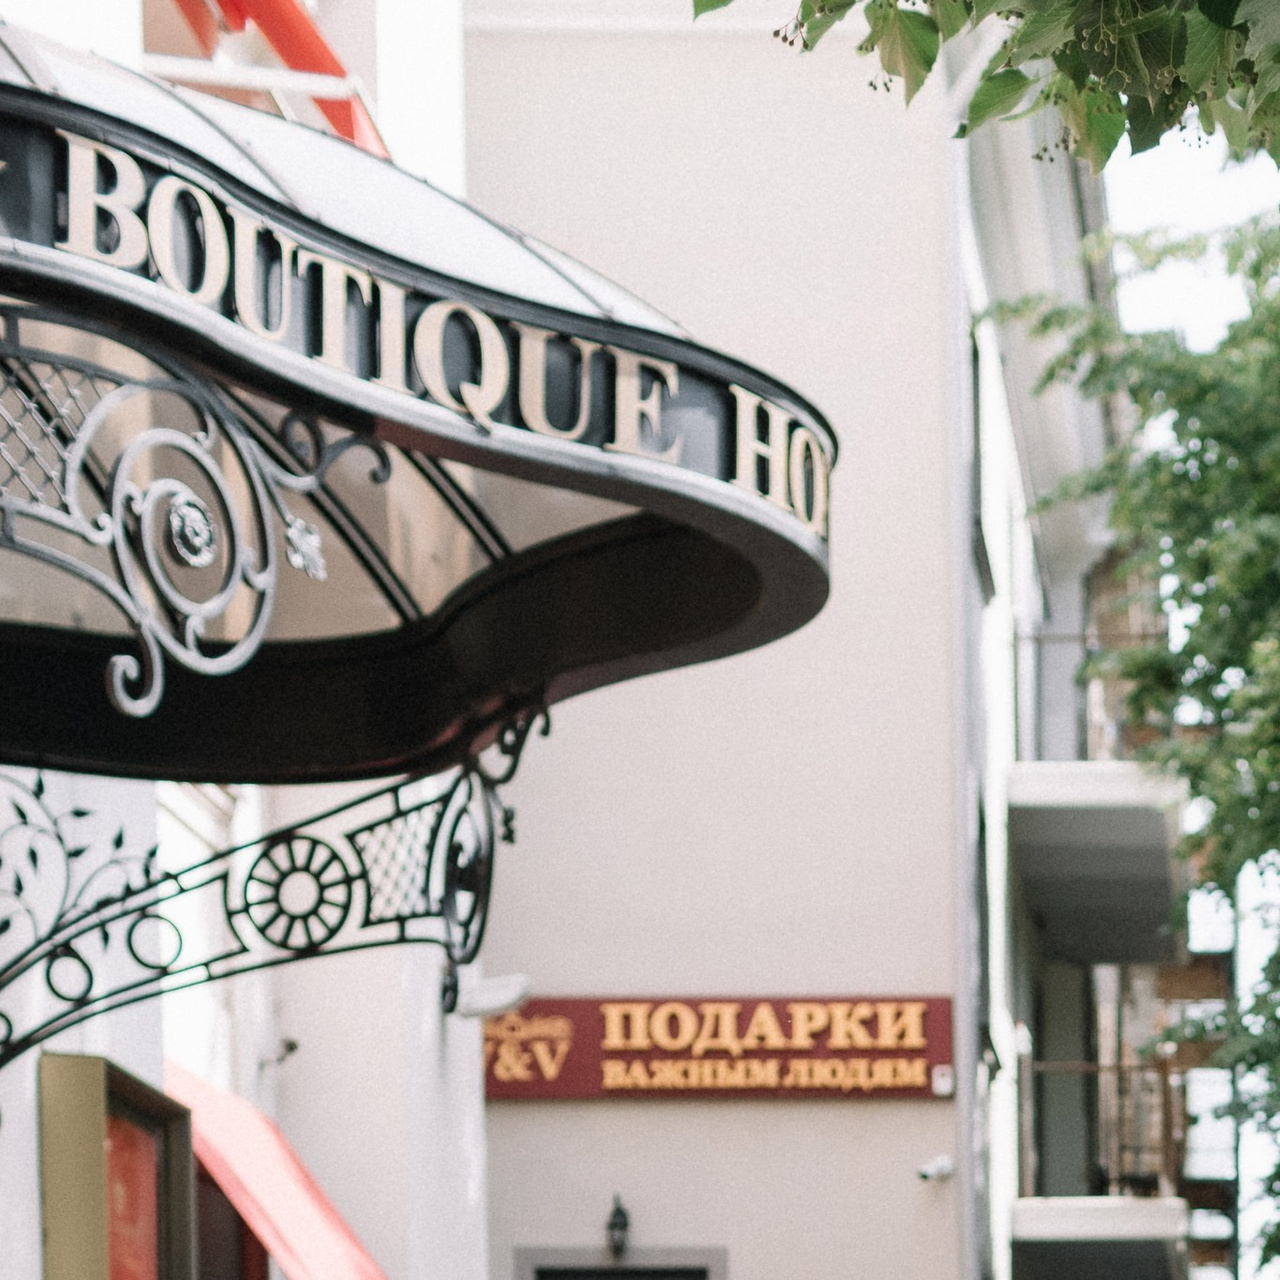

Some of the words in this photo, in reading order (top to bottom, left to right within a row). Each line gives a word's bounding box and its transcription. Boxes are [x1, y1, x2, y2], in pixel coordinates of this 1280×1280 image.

[54, 127, 681, 465] BOUTIQUE
[600, 1002, 928, 1059] ПОДАРКИ
[602, 1058, 780, 1090] ВАЖНЫМ
[782, 1057, 928, 1093] ЛЮДЯМ
